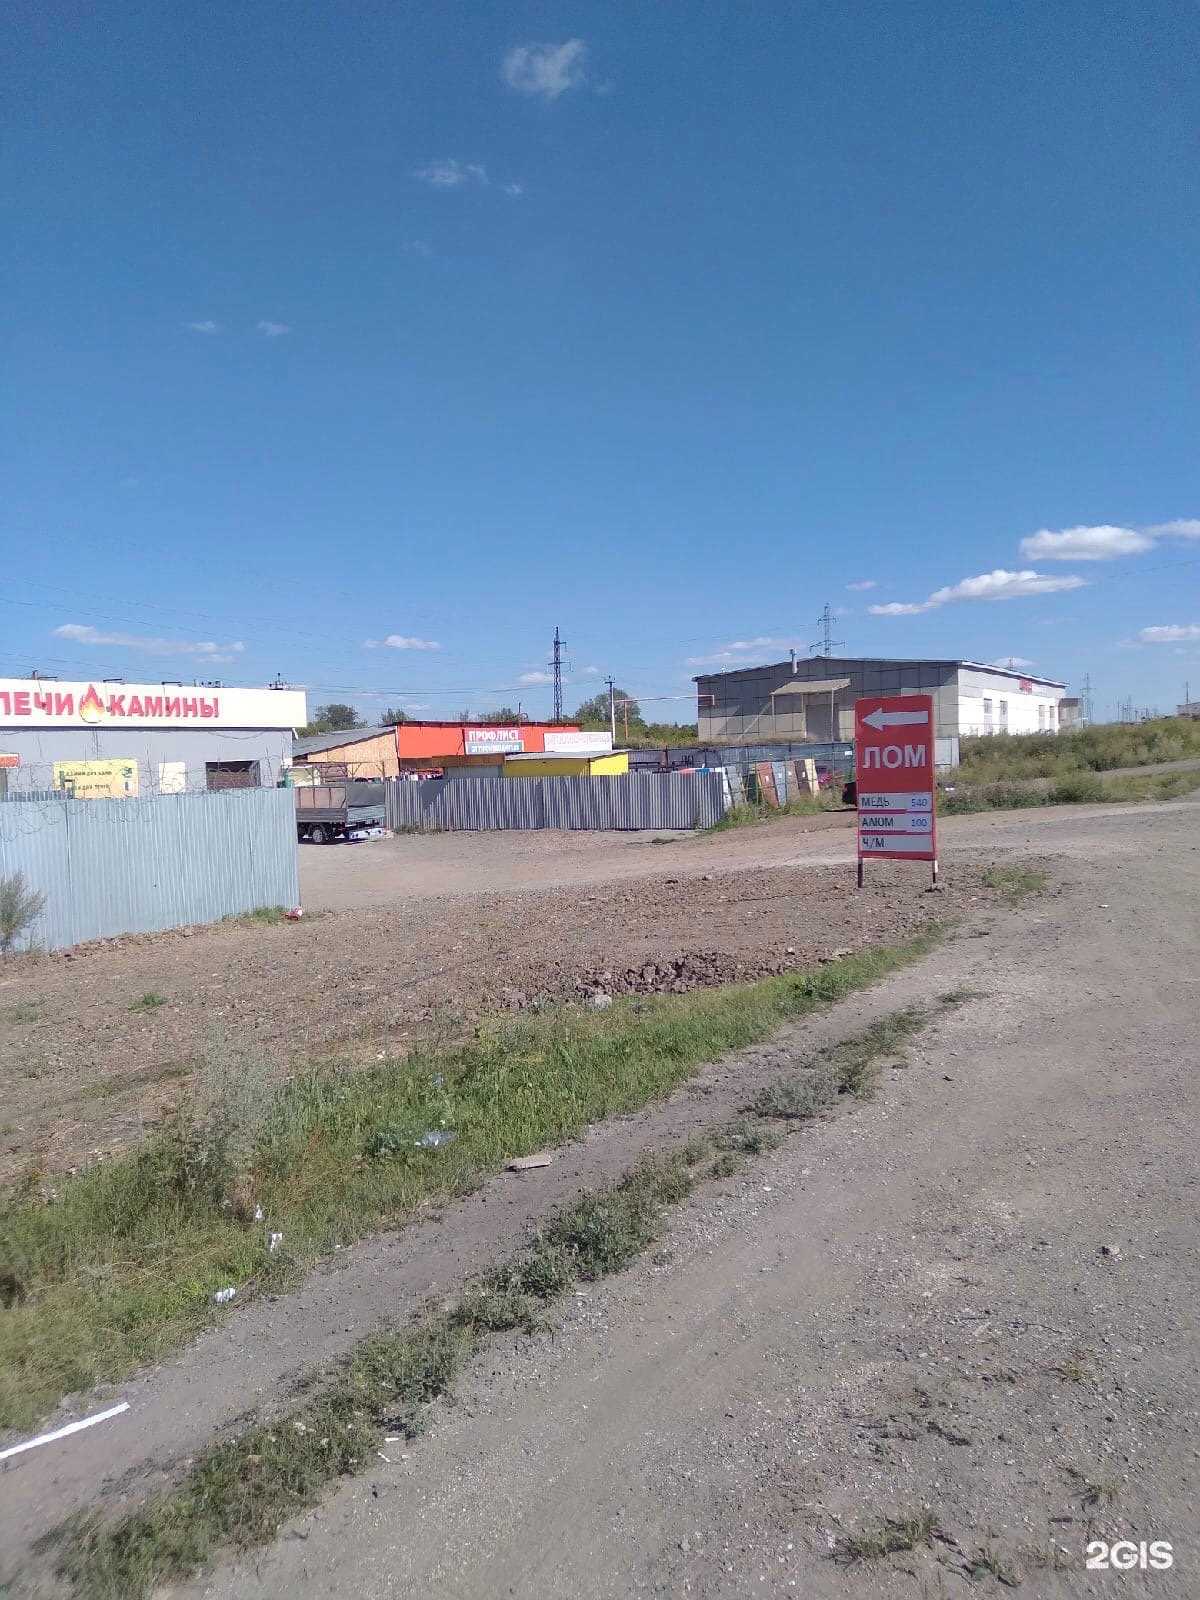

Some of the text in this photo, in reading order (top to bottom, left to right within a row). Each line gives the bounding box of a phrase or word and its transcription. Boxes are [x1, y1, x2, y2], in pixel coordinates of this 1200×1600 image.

[110, 695, 219, 718] КАМИНЫ
[469, 730, 519, 741] ПРОФЛИСТ
[862, 744, 926, 769] ЛОМ
[861, 796, 890, 808] МЕДЬ
[861, 817, 894, 827] АЛЮМ
[862, 837, 885, 849] Ч/М
